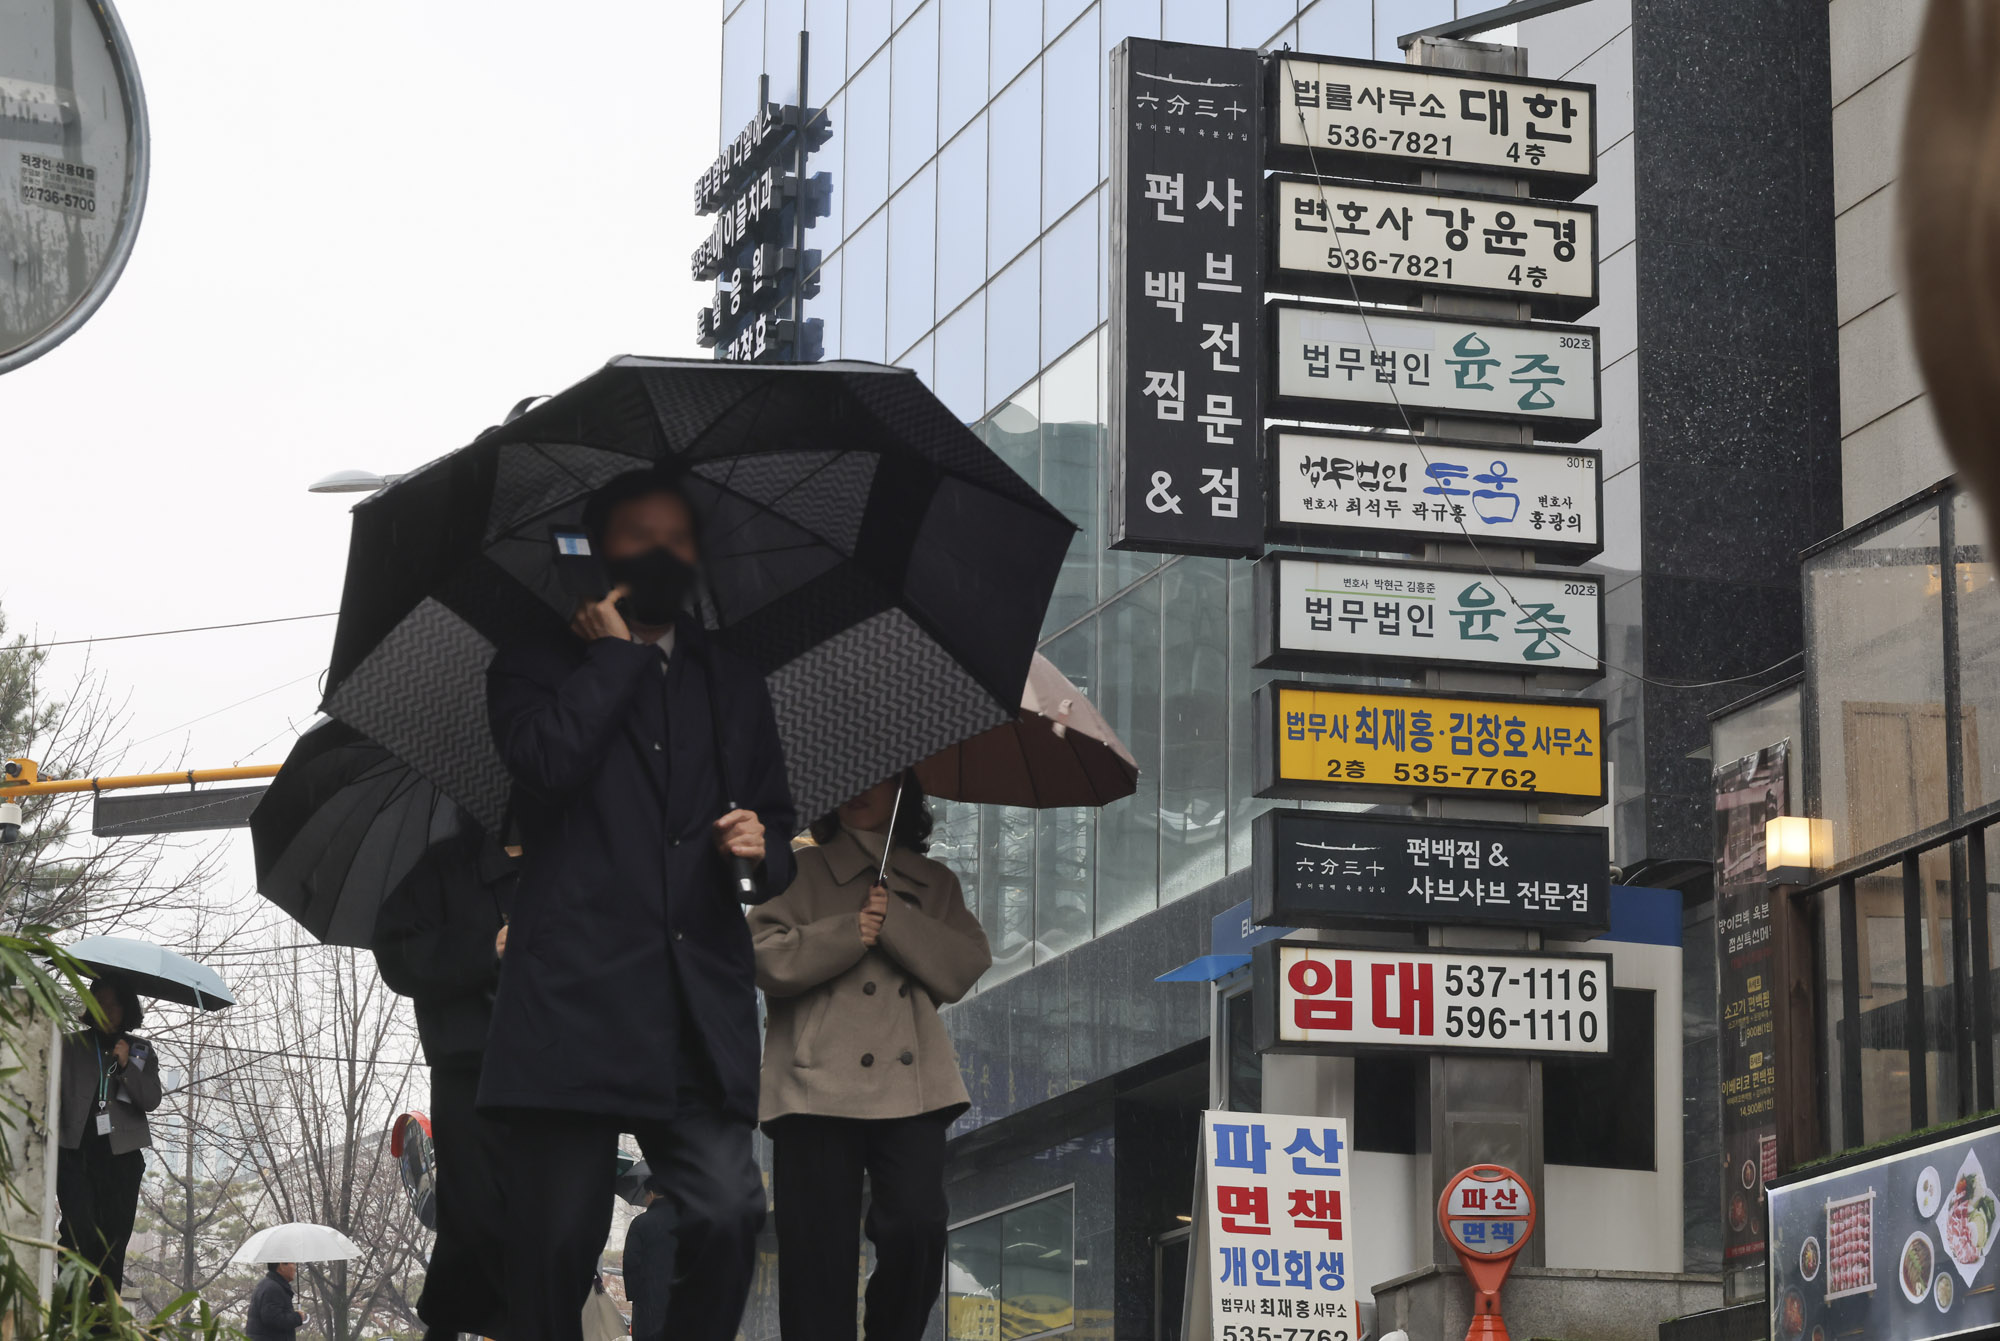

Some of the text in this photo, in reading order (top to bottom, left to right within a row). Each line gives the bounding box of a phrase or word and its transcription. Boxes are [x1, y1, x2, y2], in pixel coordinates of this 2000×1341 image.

[1136, 91, 1248, 121] 六分三十
[1293, 79, 1578, 143] 법률사무소 대한
[1326, 124, 1454, 157] 536-7821
[1506, 142, 1547, 167] 4층
[21, 154, 51, 171] 직장인
[1294, 196, 1577, 263] 변호사 강윤경
[1326, 247, 1454, 279] 536-7821
[1507, 264, 1548, 288] 4층
[1559, 336, 1593, 350] 302호
[1303, 331, 1566, 411] 법무법인 윤중
[1566, 457, 1594, 469] 301호
[1299, 455, 1521, 525] 법무법인 도움
[1538, 494, 1573, 510] 변호사
[1303, 497, 1338, 512] 변호사
[1346, 497, 1401, 519] 최석두
[1529, 511, 1581, 533] 홍광의
[1343, 578, 1369, 589] 변호사
[1374, 579, 1404, 591] 박현근
[1564, 584, 1597, 597] 202호
[1305, 581, 1572, 661] 법무법인 윤중
[1286, 711, 1349, 743] 법무사
[1532, 726, 1594, 756] 사무소
[1327, 759, 1366, 778] 2층
[1393, 762, 1537, 789] 535-7762
[1296, 857, 1385, 877] 六分三十
[1406, 837, 1510, 870] 편백찜 &
[1407, 875, 1588, 912] 샤브샤브 전문점
[1729, 925, 1772, 954] 점심특선메
[1288, 959, 1434, 1036] 임대
[1445, 964, 1597, 1002] 537-1116
[1445, 1005, 1598, 1043] 596-1110
[1212, 1123, 1344, 1177] 파산
[1217, 1185, 1343, 1241] 면책
[1461, 1188, 1518, 1211] 파산
[1462, 1222, 1515, 1245] 면책
[1219, 1246, 1345, 1292] 개인회생
[1221, 1298, 1347, 1319] 법무사 최재홍 사무소
